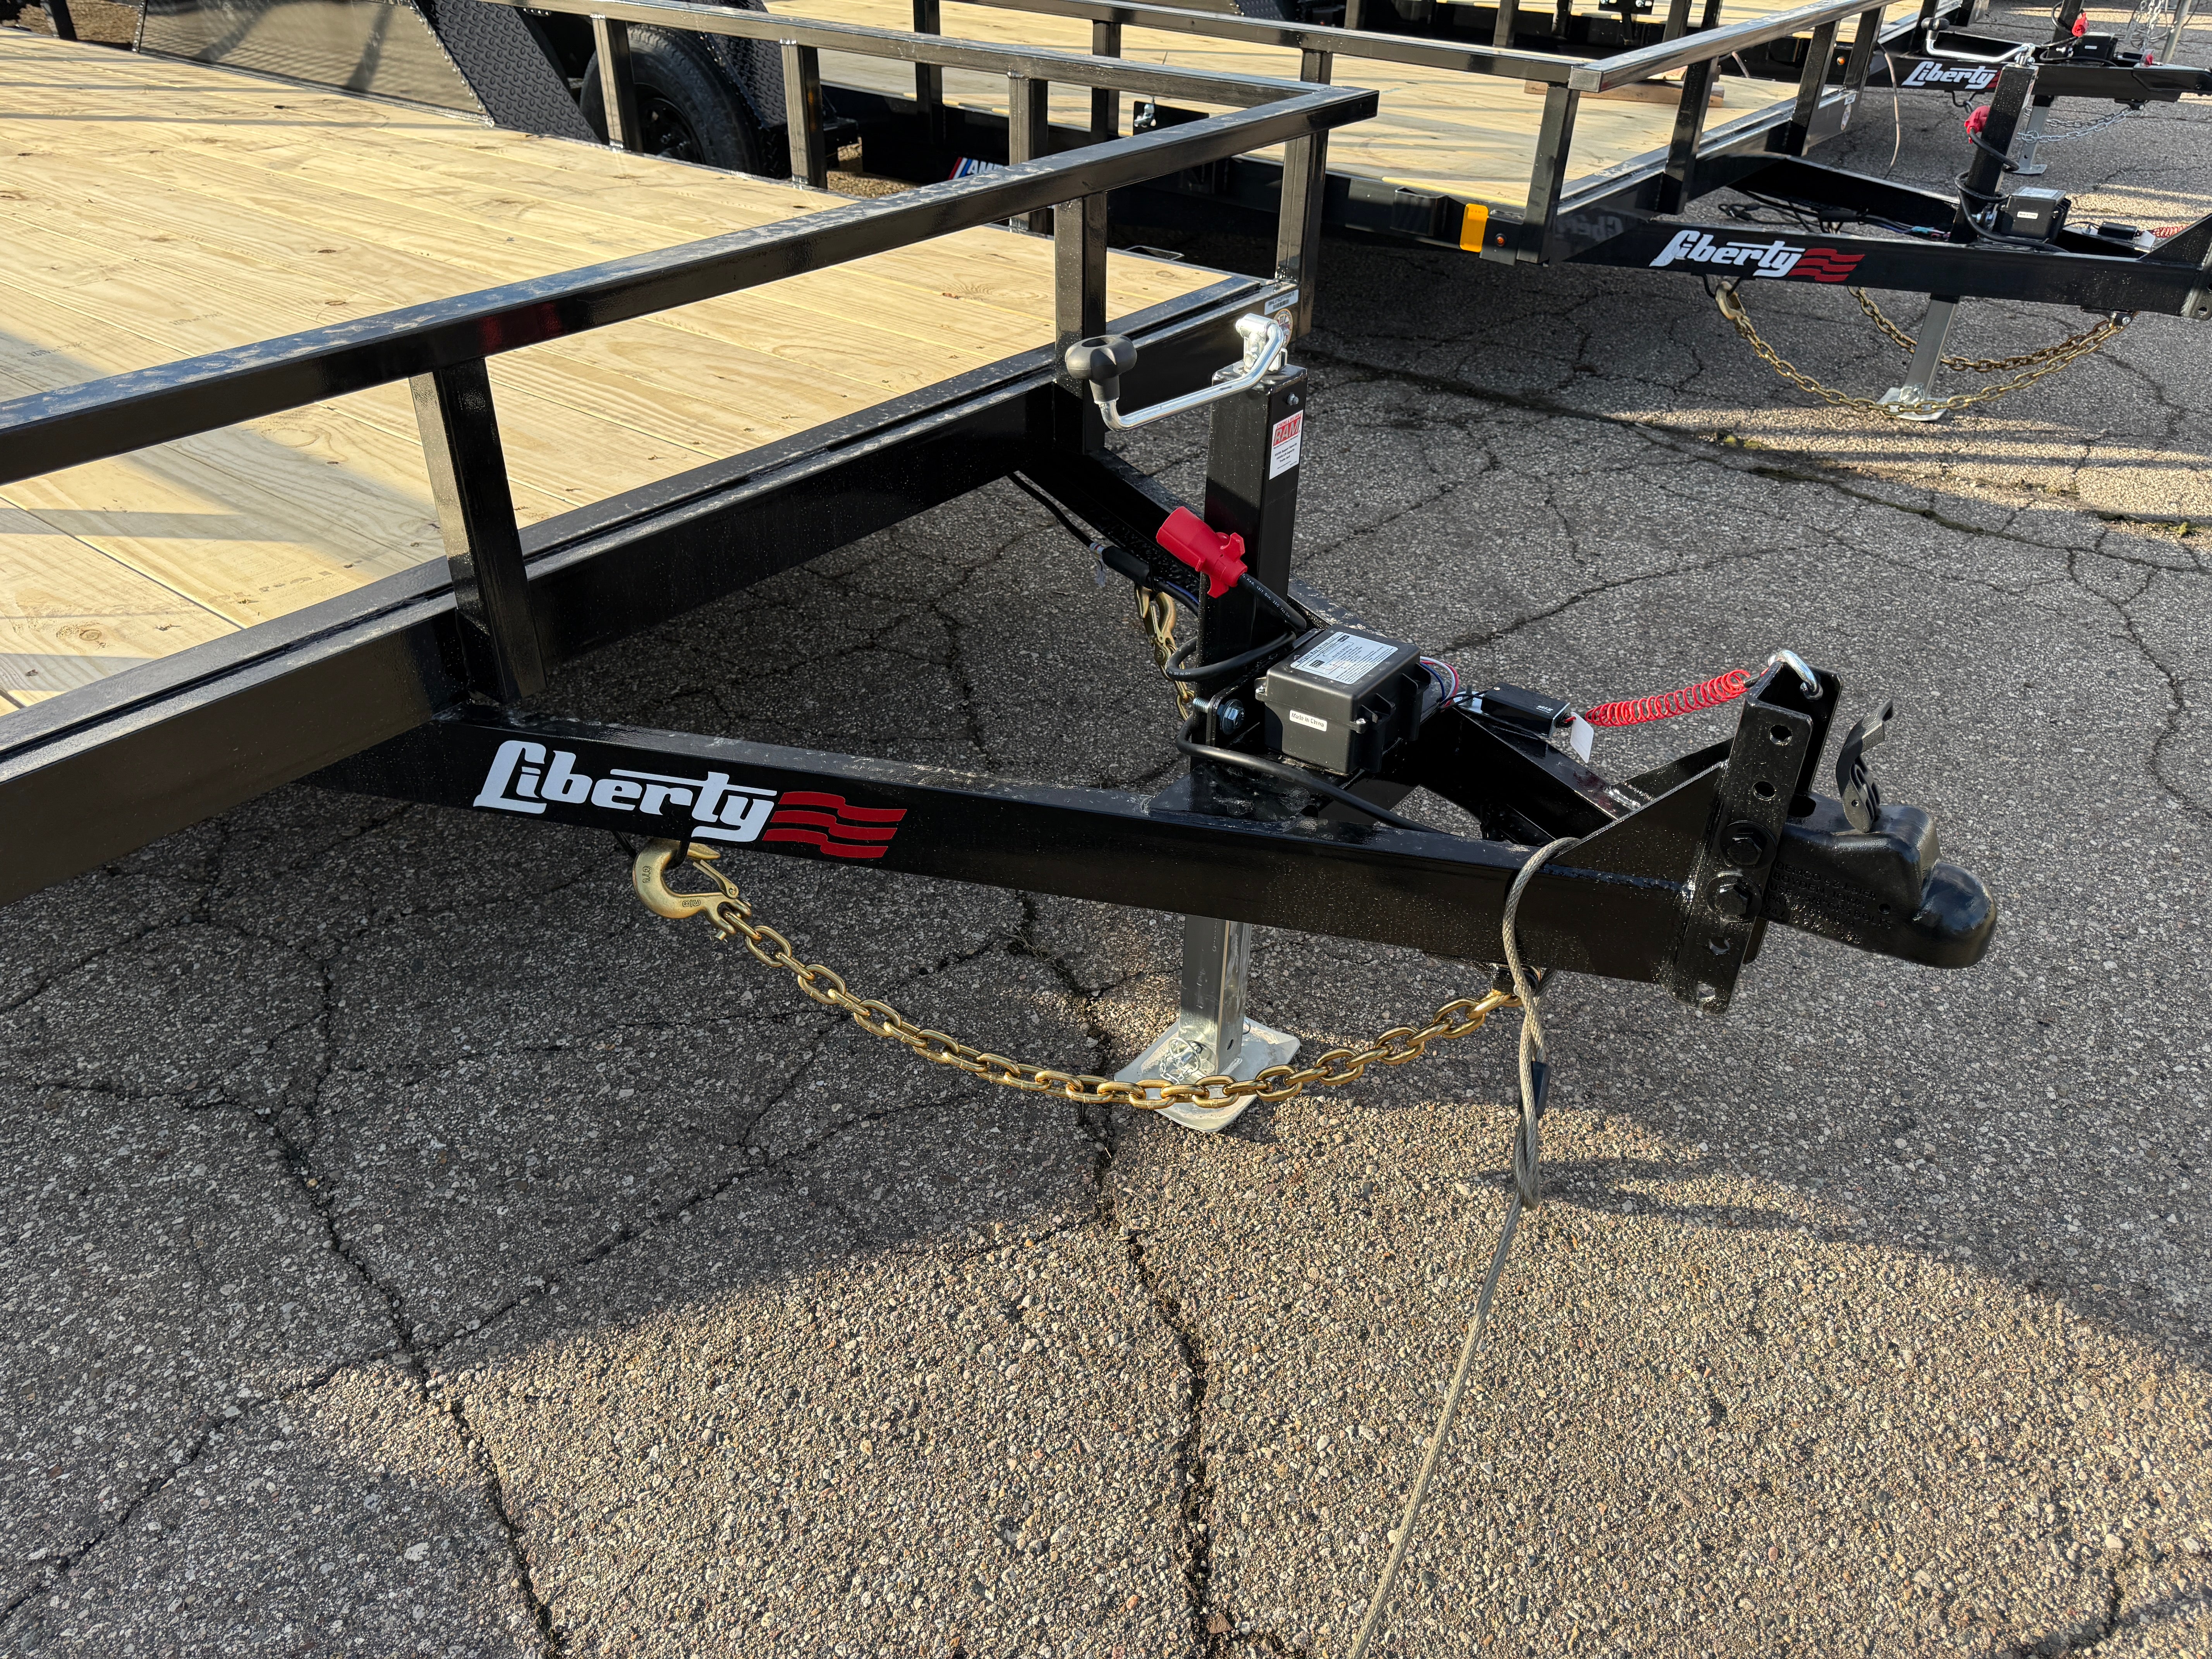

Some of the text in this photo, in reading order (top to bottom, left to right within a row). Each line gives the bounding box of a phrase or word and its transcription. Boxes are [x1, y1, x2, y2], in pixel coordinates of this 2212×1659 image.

[1901, 61, 1997, 89] Liberty
[1649, 230, 1805, 278] Liberty
[1274, 418, 1300, 446] RAM
[1310, 718, 1324, 727] China
[473, 740, 777, 842] Liberty
[1775, 861, 1821, 882] DEMCO
[1769, 882, 1792, 898] USE
[1854, 910, 1892, 929] BOLTS
[1832, 891, 1865, 909] IOWA
